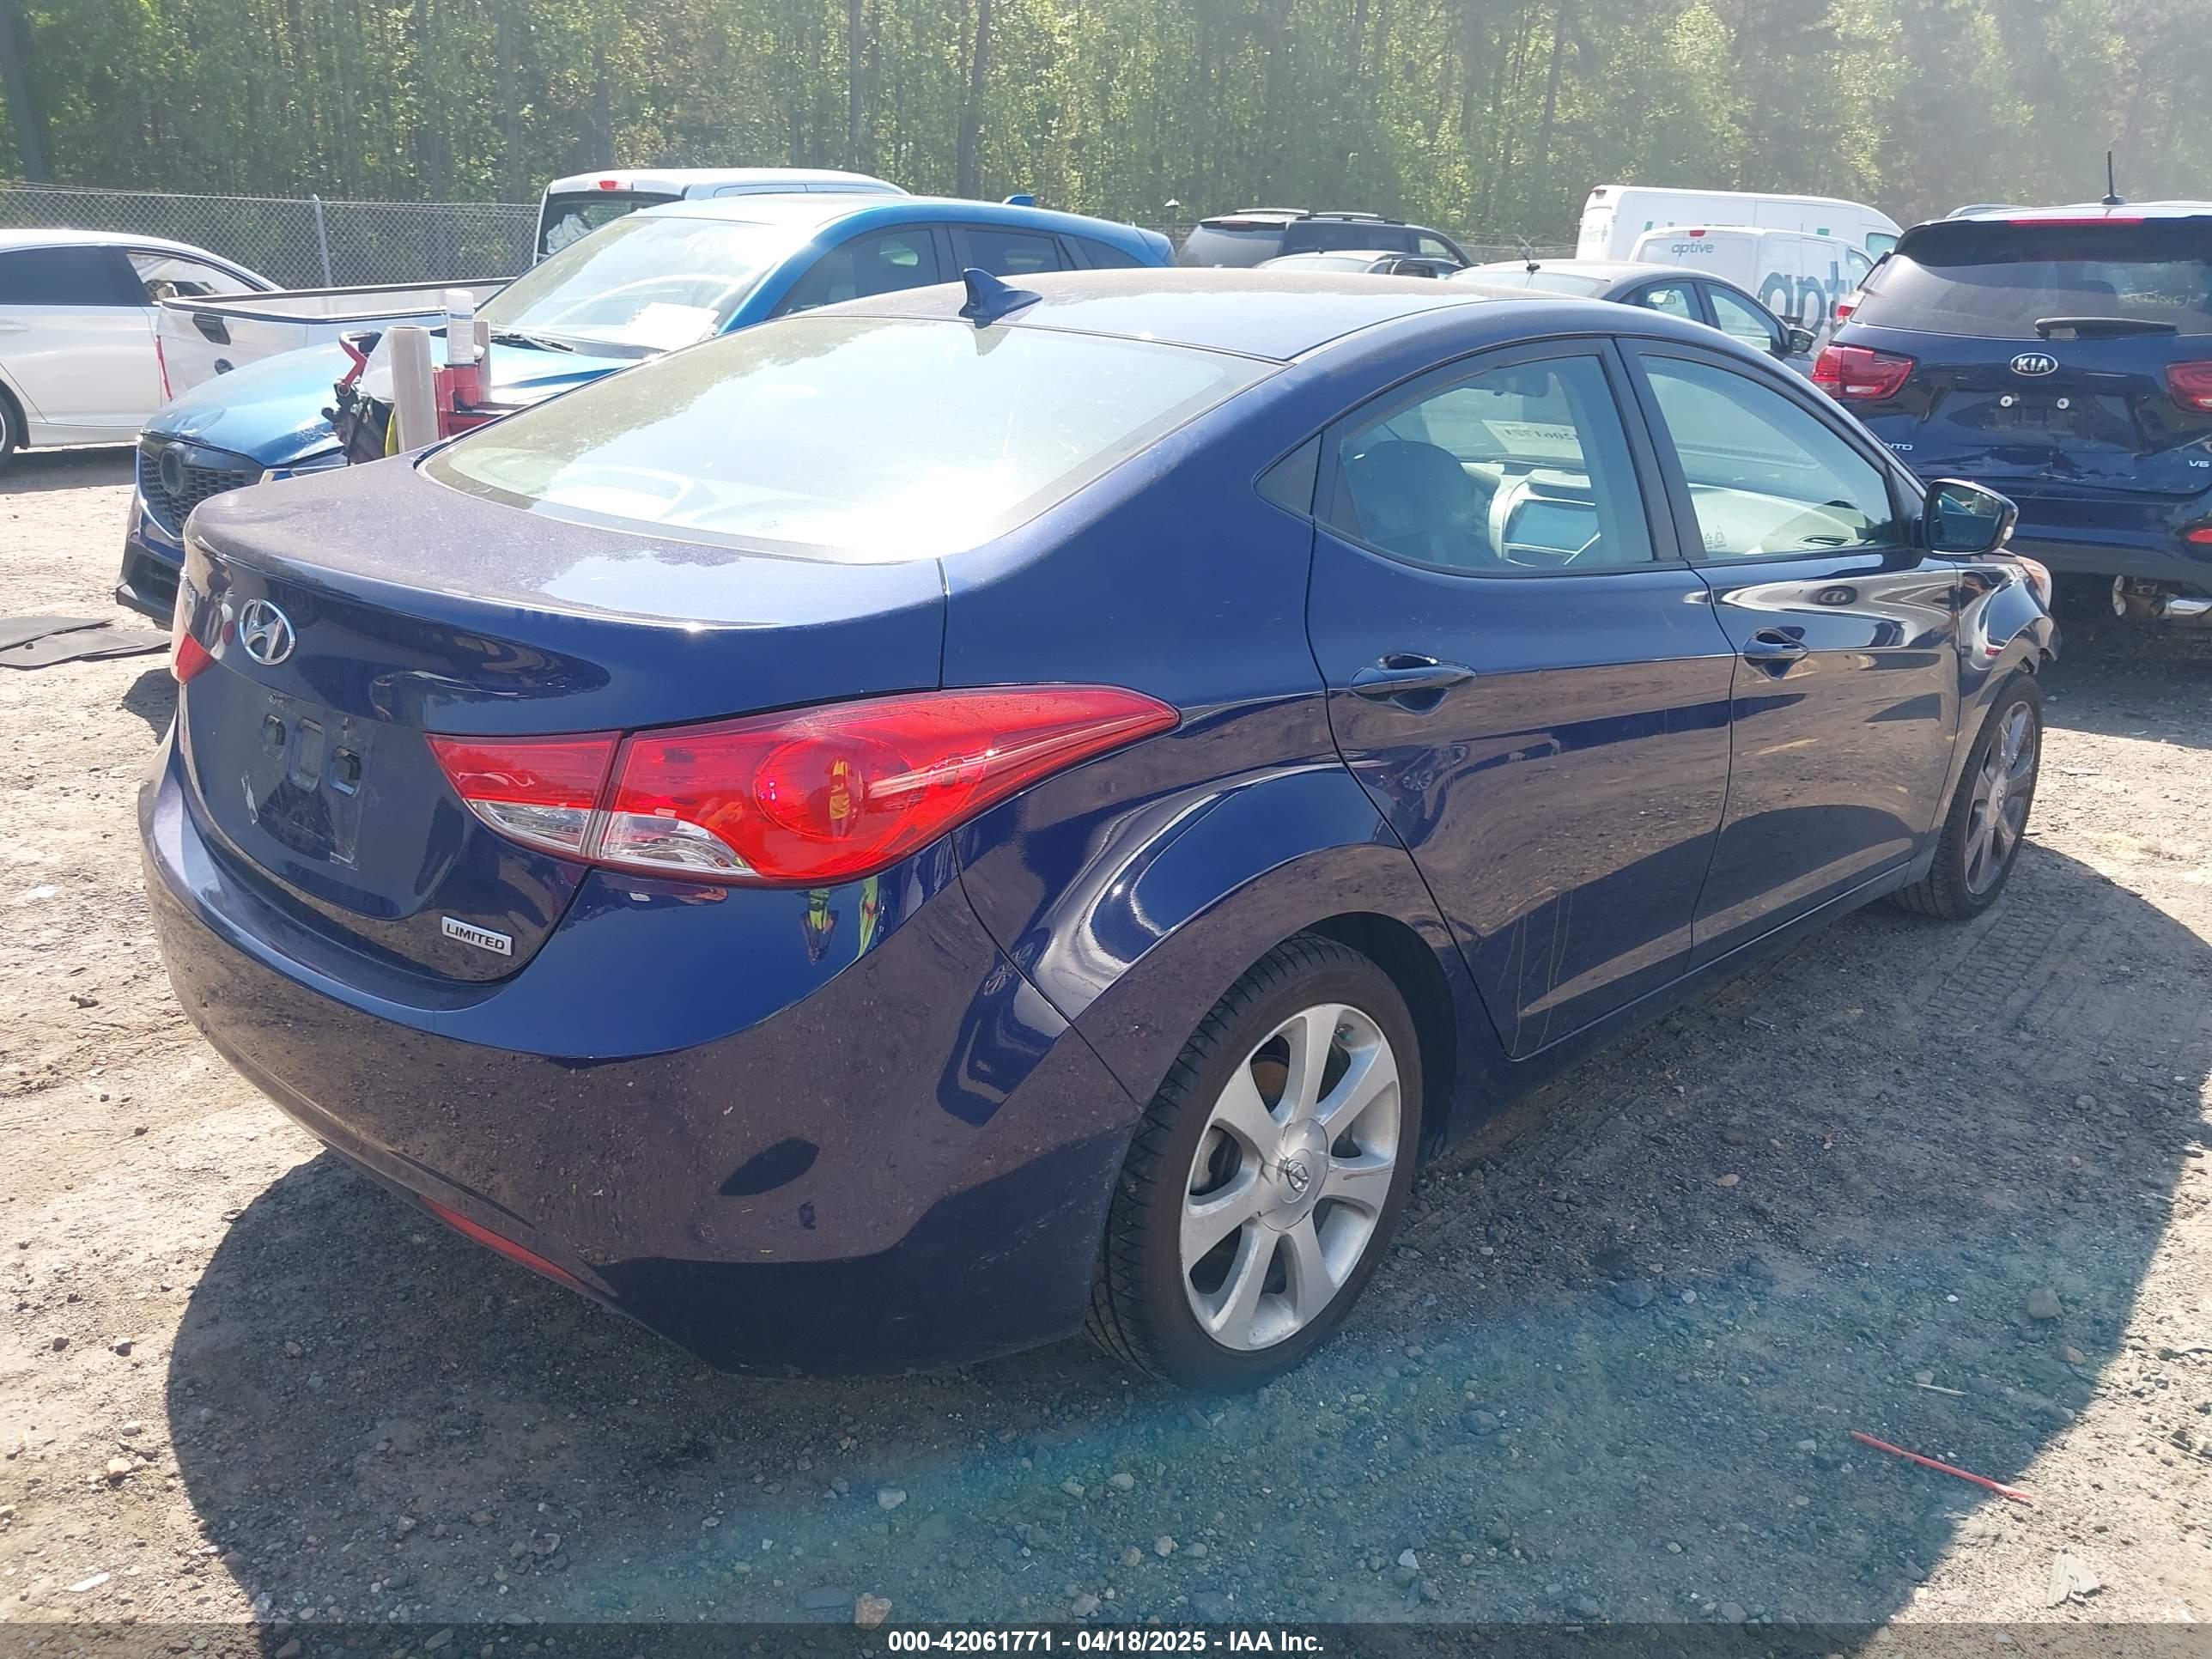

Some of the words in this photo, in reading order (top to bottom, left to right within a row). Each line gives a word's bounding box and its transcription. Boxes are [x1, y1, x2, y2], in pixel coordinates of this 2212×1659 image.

[1671, 240, 1715, 257] aptive
[2016, 357, 2050, 372] KIA
[2188, 459, 2210, 468] V6
[447, 923, 505, 950] LIMITED
